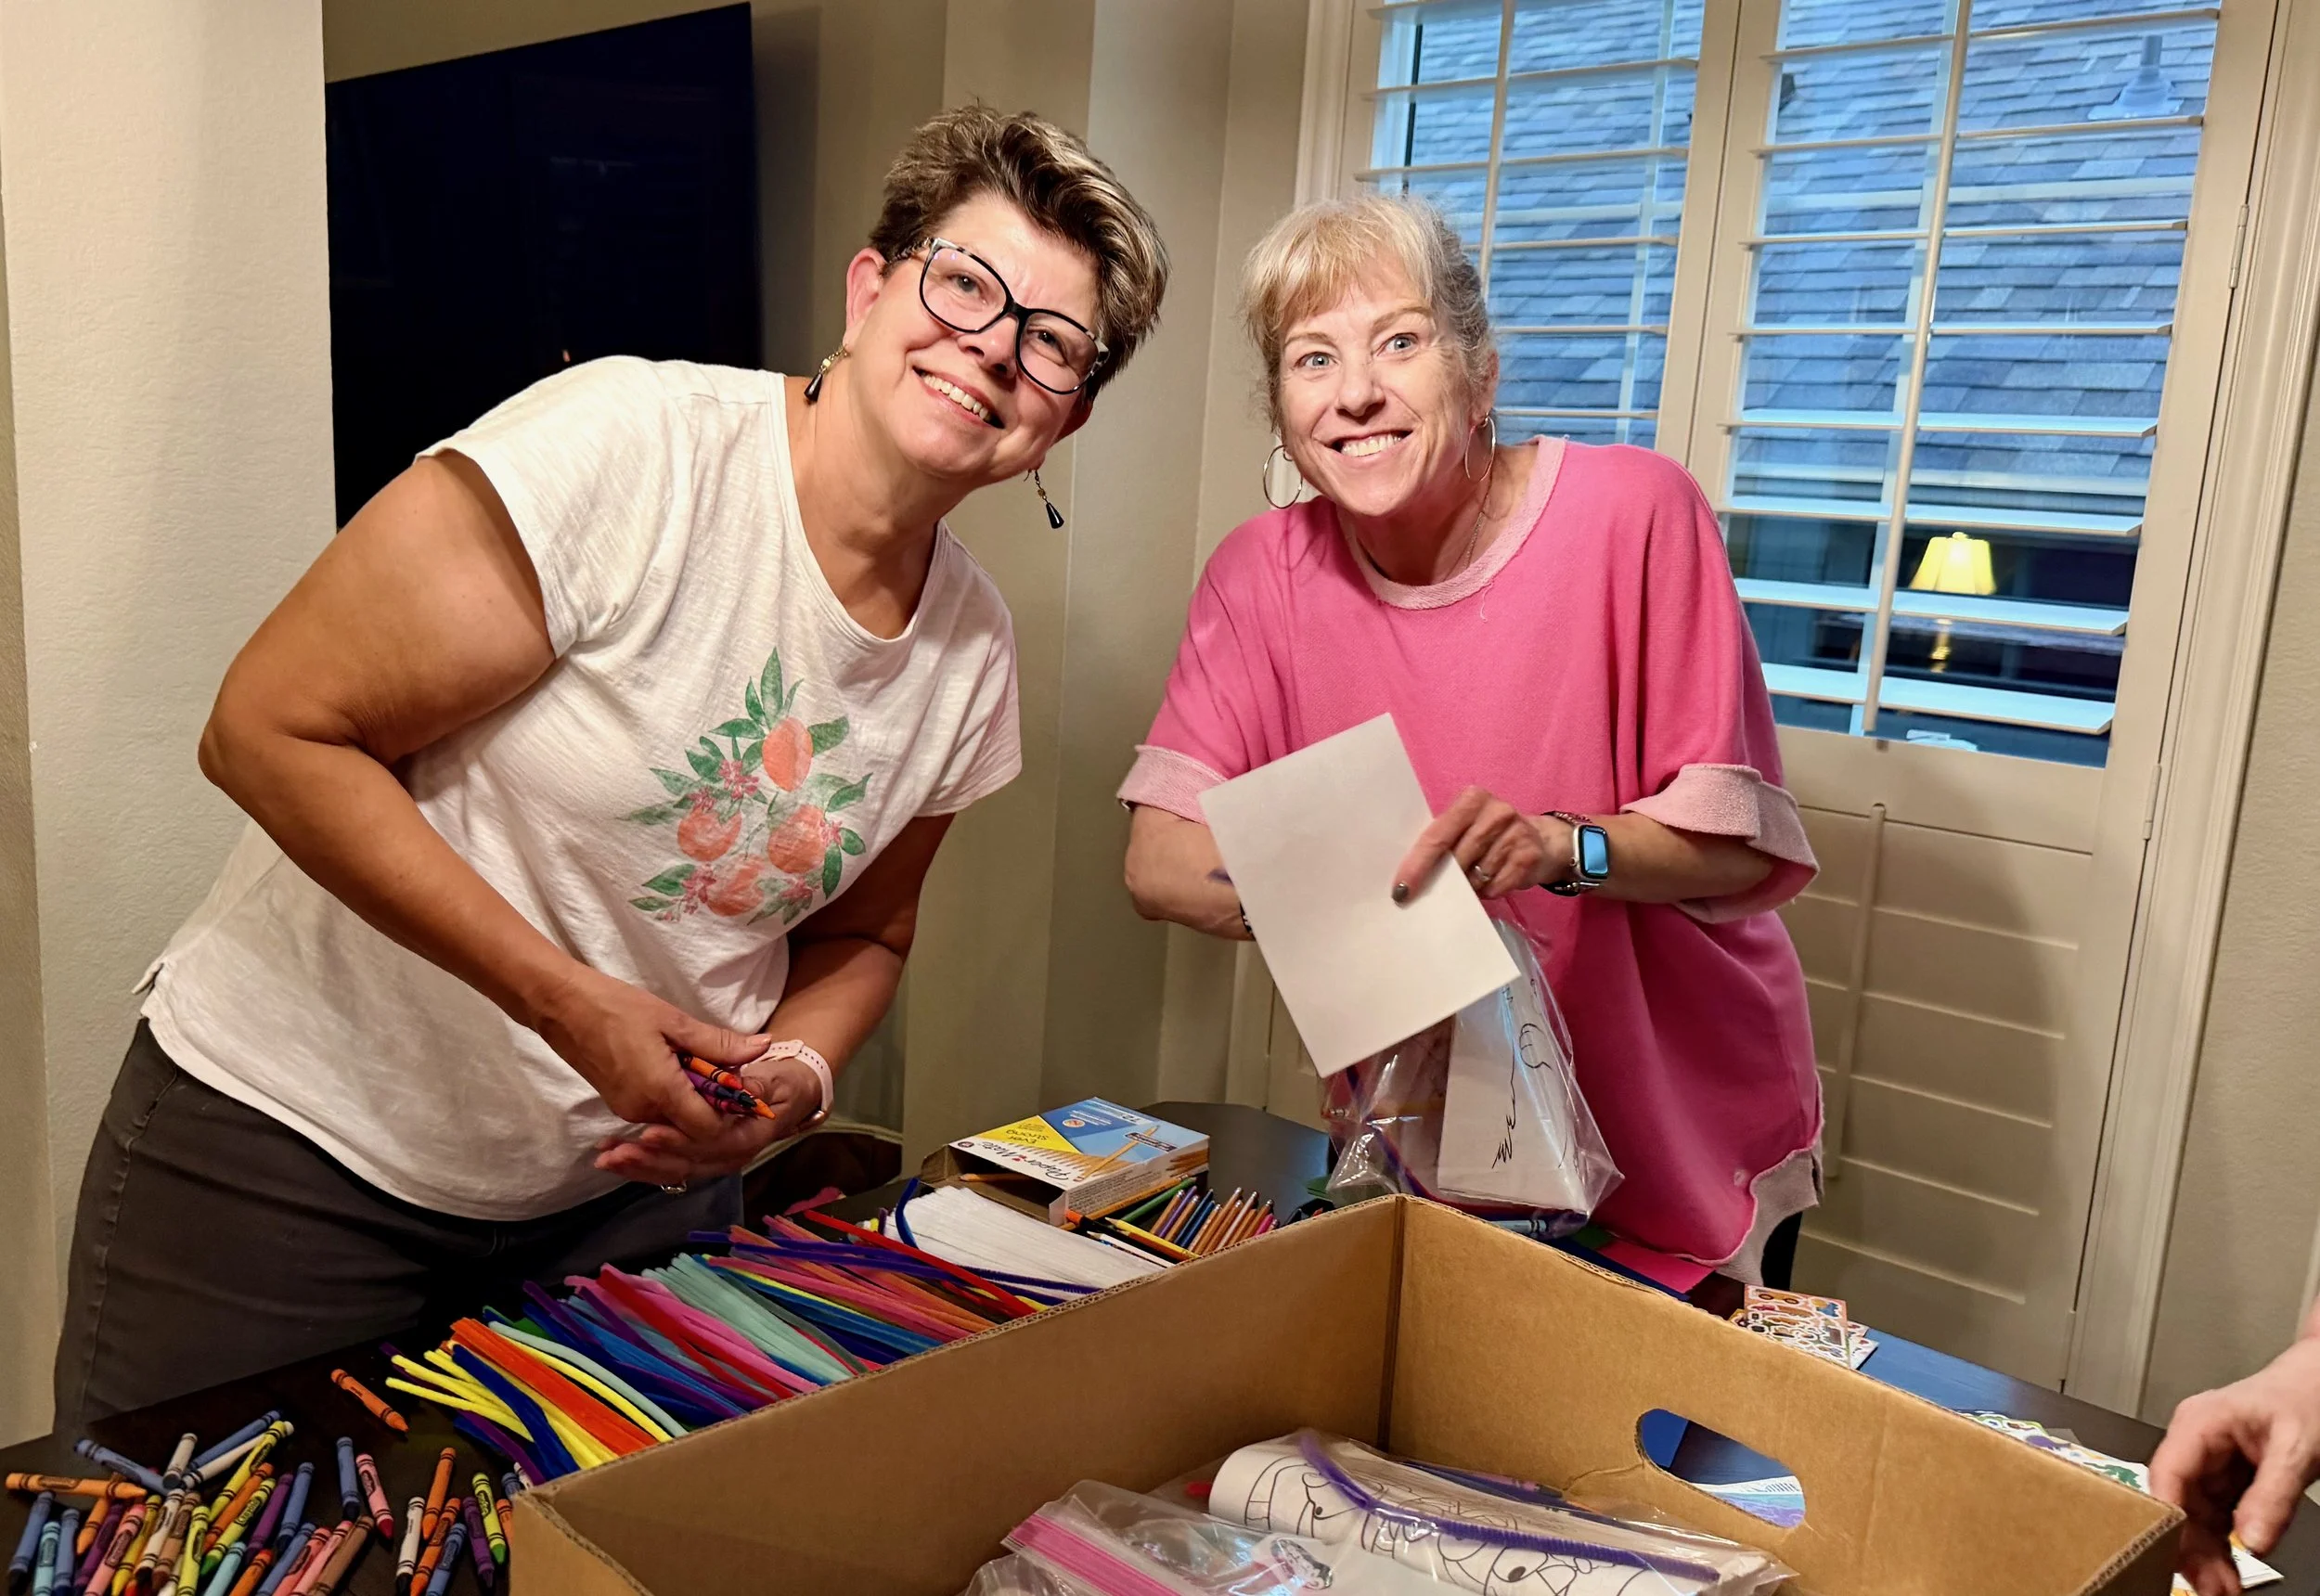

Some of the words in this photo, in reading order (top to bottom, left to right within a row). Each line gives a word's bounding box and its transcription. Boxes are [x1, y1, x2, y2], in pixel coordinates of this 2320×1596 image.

[1009, 1135, 1038, 1144] Ever
[982, 1141, 1017, 1158] Mate
[1024, 1159, 1070, 1181] Paper
